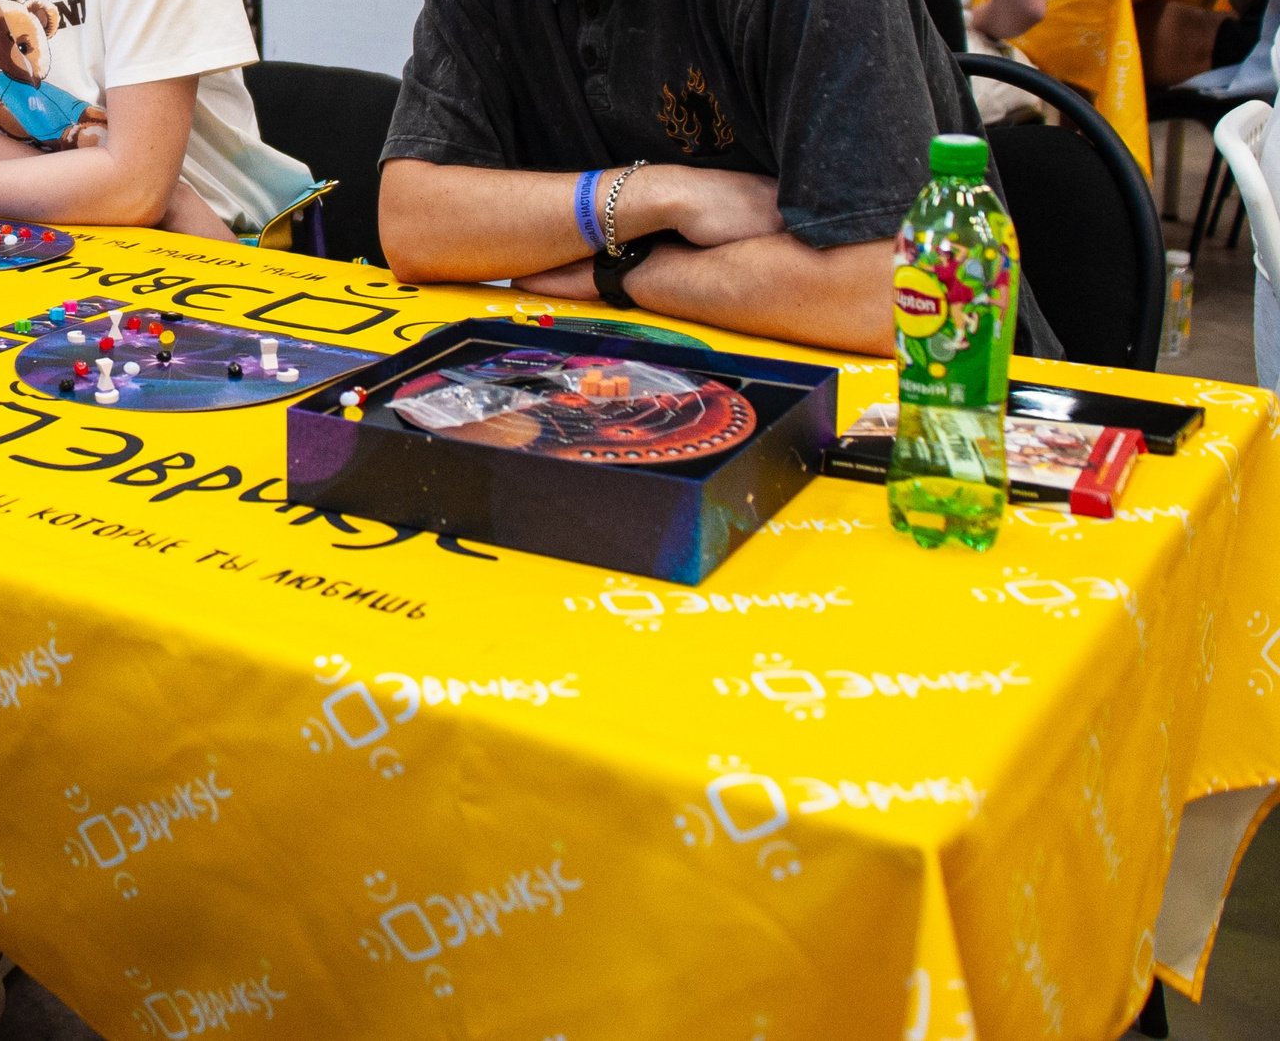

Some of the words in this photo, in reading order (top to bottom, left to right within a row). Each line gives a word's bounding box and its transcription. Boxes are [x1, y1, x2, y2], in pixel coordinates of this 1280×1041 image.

[667, 587, 854, 614] Эврикус
[374, 671, 581, 724] Эврикус
[825, 662, 1031, 699] Эврикус
[113, 771, 233, 852] Эврикус
[424, 861, 583, 947] Эврикус
[174, 975, 287, 1033] Эврикус
